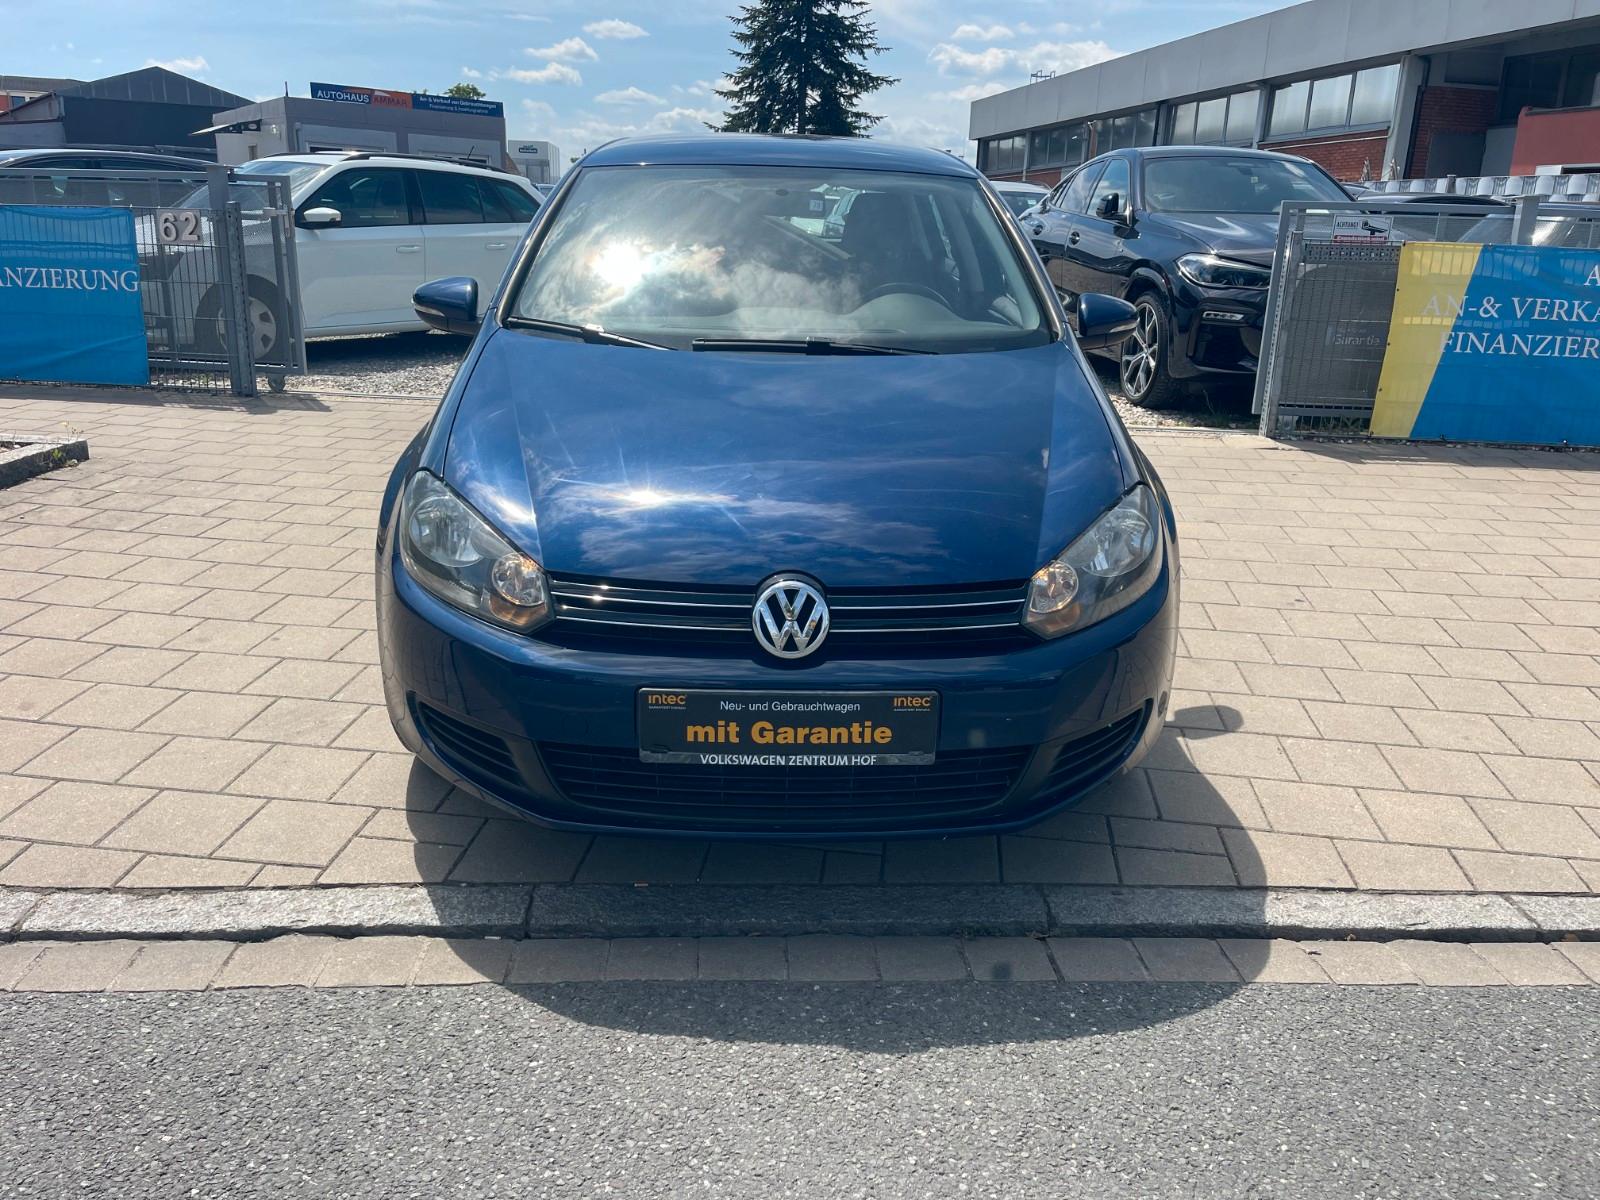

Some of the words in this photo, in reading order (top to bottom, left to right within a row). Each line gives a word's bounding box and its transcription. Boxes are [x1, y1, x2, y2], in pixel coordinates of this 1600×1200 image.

[316, 90, 370, 103] AUTOHAUS
[159, 211, 200, 242] 62
[1440, 331, 1600, 358] FINANZIER
[648, 694, 686, 705] intec
[893, 696, 931, 707] intec
[720, 701, 746, 711] Neu-
[749, 701, 769, 711] und
[771, 701, 861, 713] Gebrauchtwagen
[686, 720, 740, 743] mit
[751, 720, 893, 744] Garantie
[700, 754, 786, 766] VOLKSWAGEN
[788, 755, 849, 766] ZENTRUM
[851, 755, 878, 767] HOF
